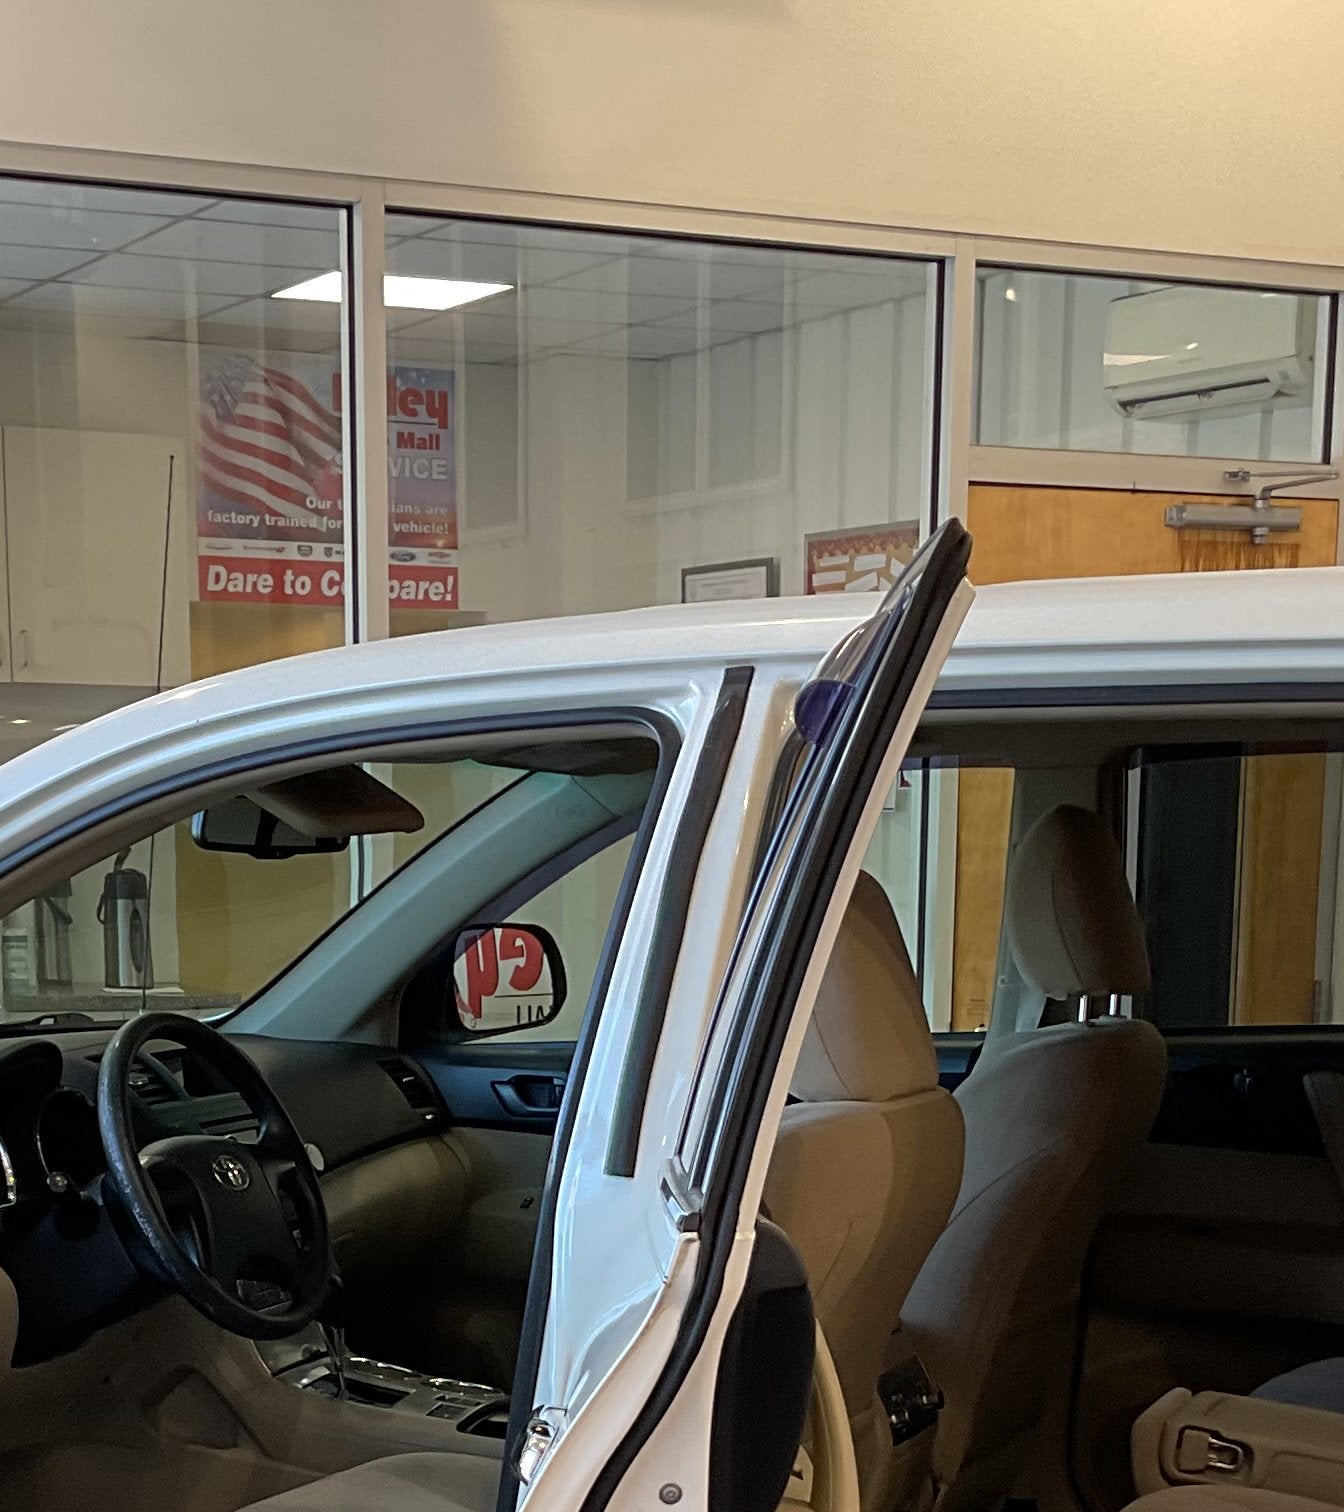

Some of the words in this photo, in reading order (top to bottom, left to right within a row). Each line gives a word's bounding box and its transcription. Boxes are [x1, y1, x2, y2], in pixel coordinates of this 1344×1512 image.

[396, 431, 441, 451] Mall
[306, 496, 331, 510] Our
[425, 507, 449, 517] are
[207, 510, 261, 527] factory
[265, 513, 318, 528] trained
[323, 515, 343, 533] for
[393, 519, 449, 536] vehicle!
[207, 564, 274, 594] Dare
[283, 569, 312, 595] to
